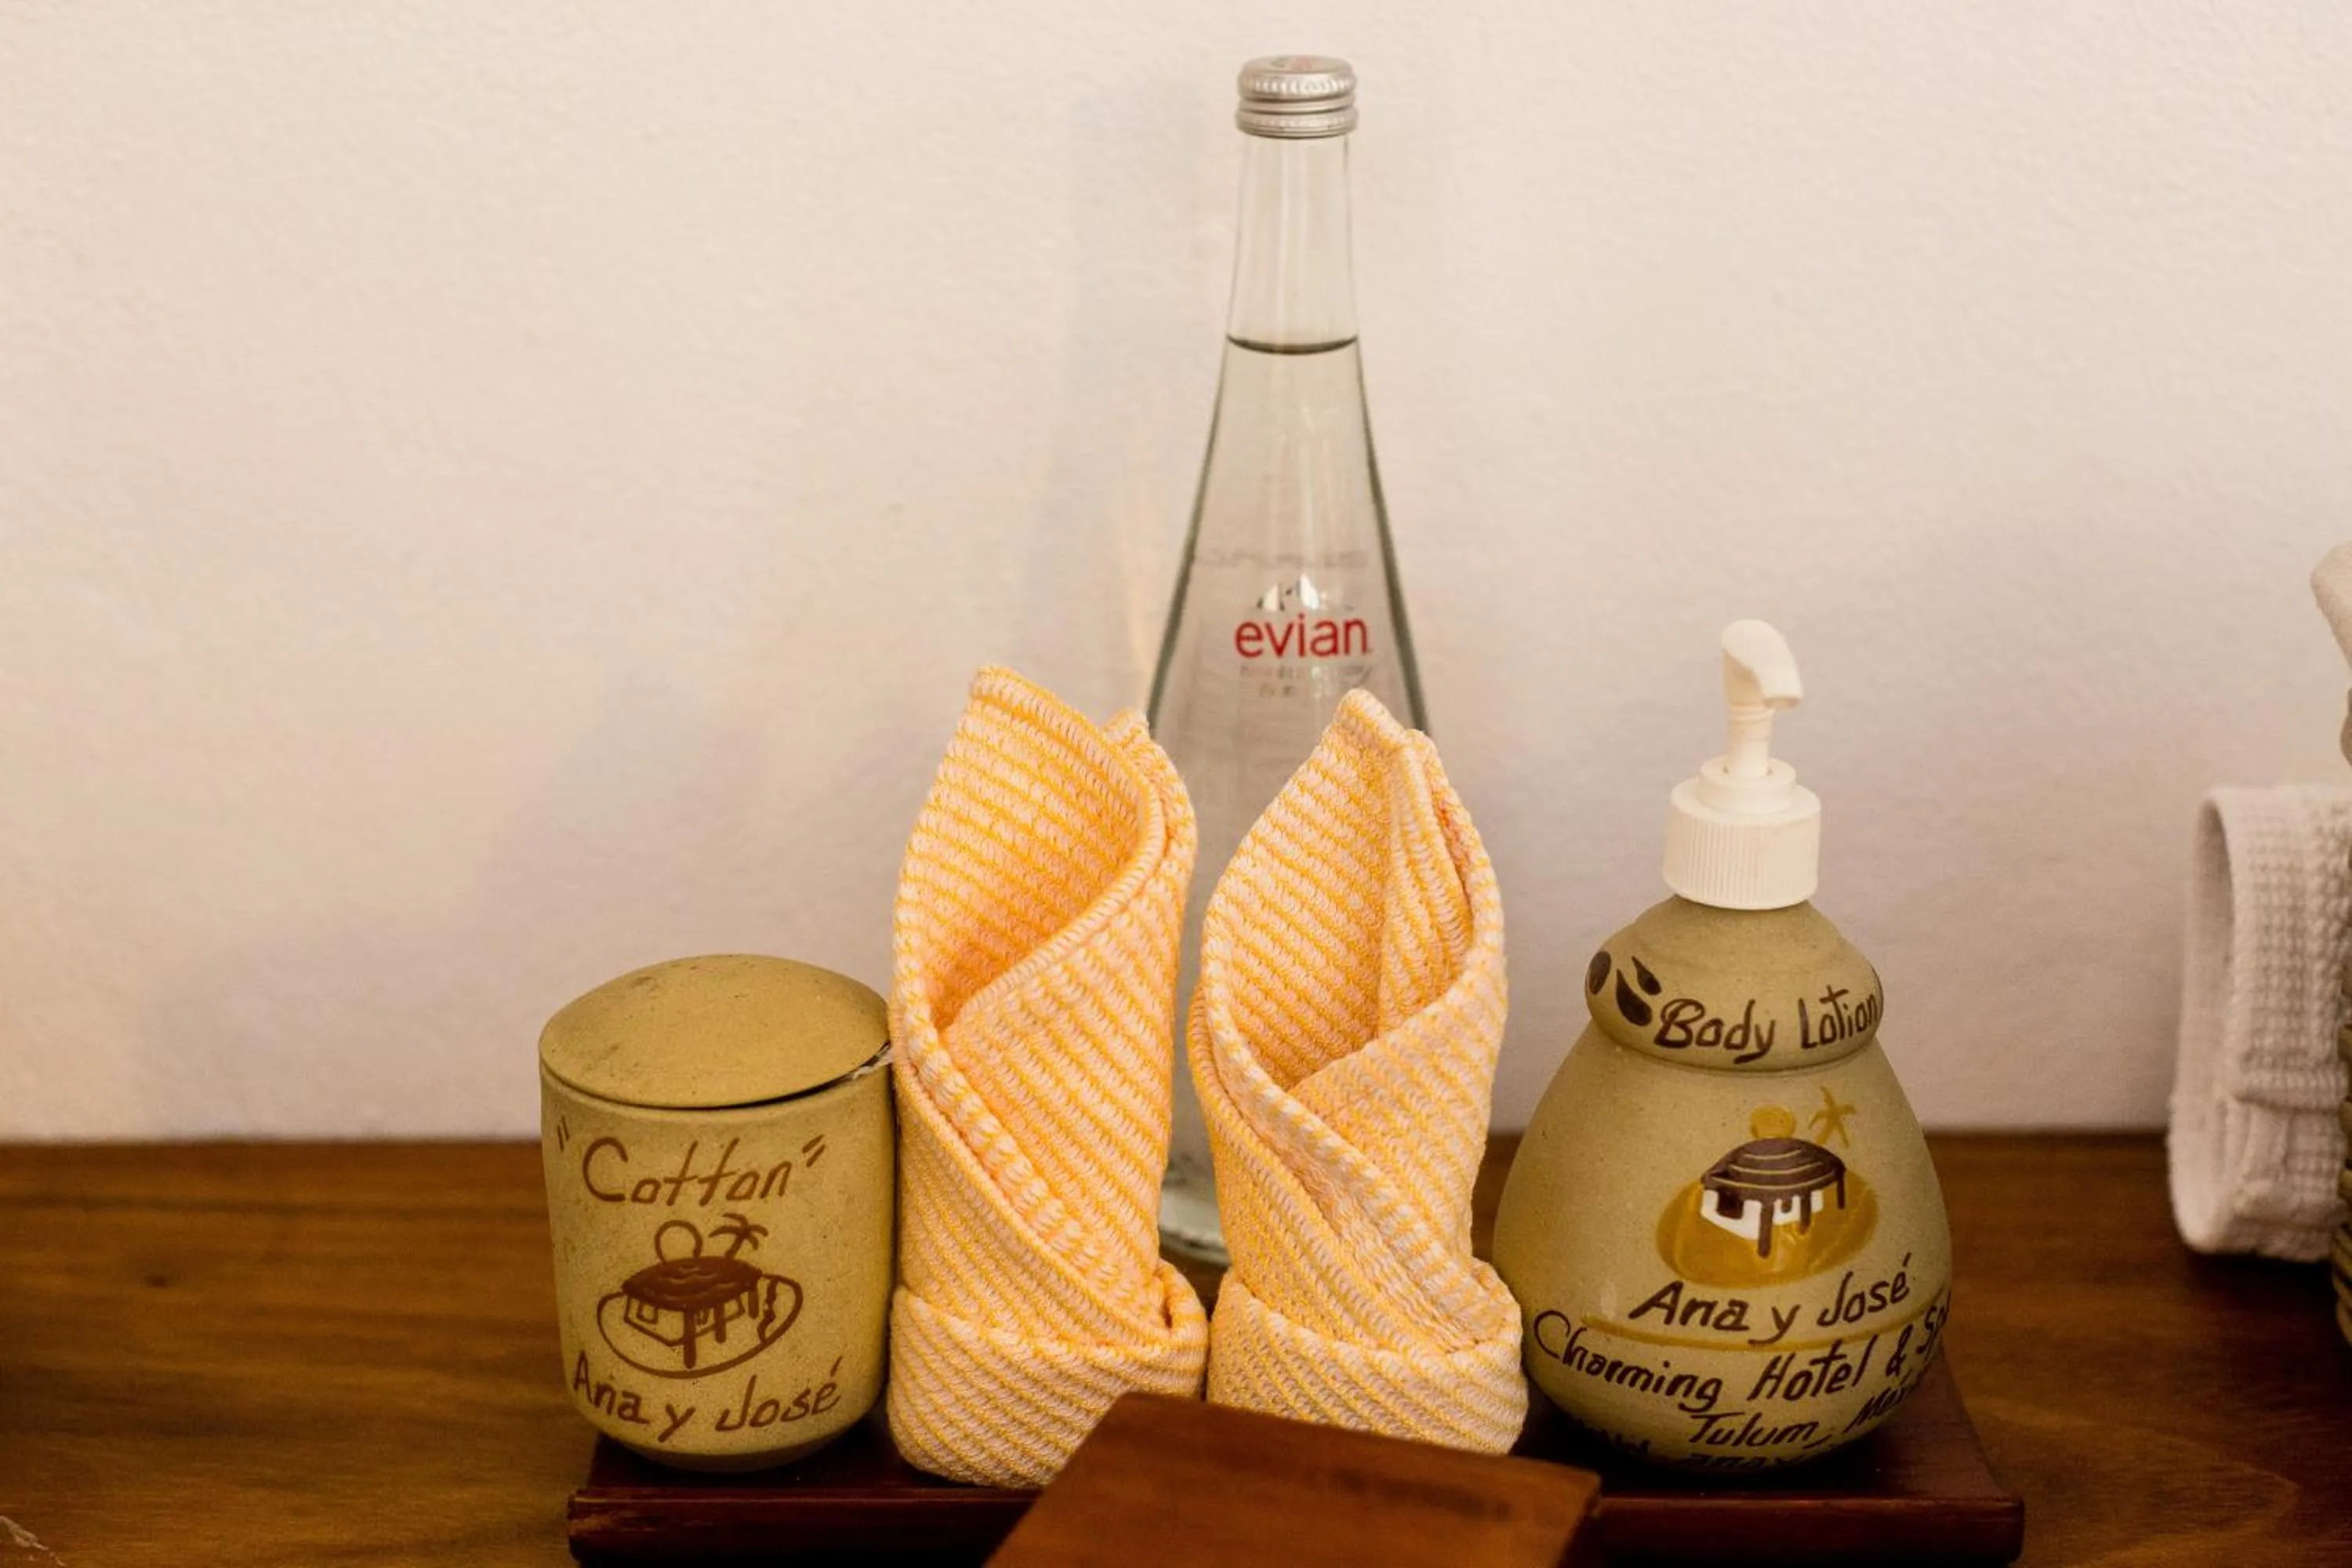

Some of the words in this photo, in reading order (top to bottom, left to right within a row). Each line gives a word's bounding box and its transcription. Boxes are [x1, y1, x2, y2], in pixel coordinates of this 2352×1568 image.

[1234, 612, 1369, 659] evian
[1653, 998, 1776, 1065] Body
[1798, 985, 1878, 1050] Lotion
[1628, 1280, 1751, 1332] Ana
[1748, 1304, 1801, 1345] y
[1817, 1252, 1913, 1327] José
[572, 1349, 649, 1425] Ana
[657, 1403, 696, 1443] y
[715, 1356, 842, 1432] José
[1533, 1309, 1723, 1413] Charming
[1746, 1333, 1878, 1402] Hotel
[1885, 1323, 1914, 1377] &
